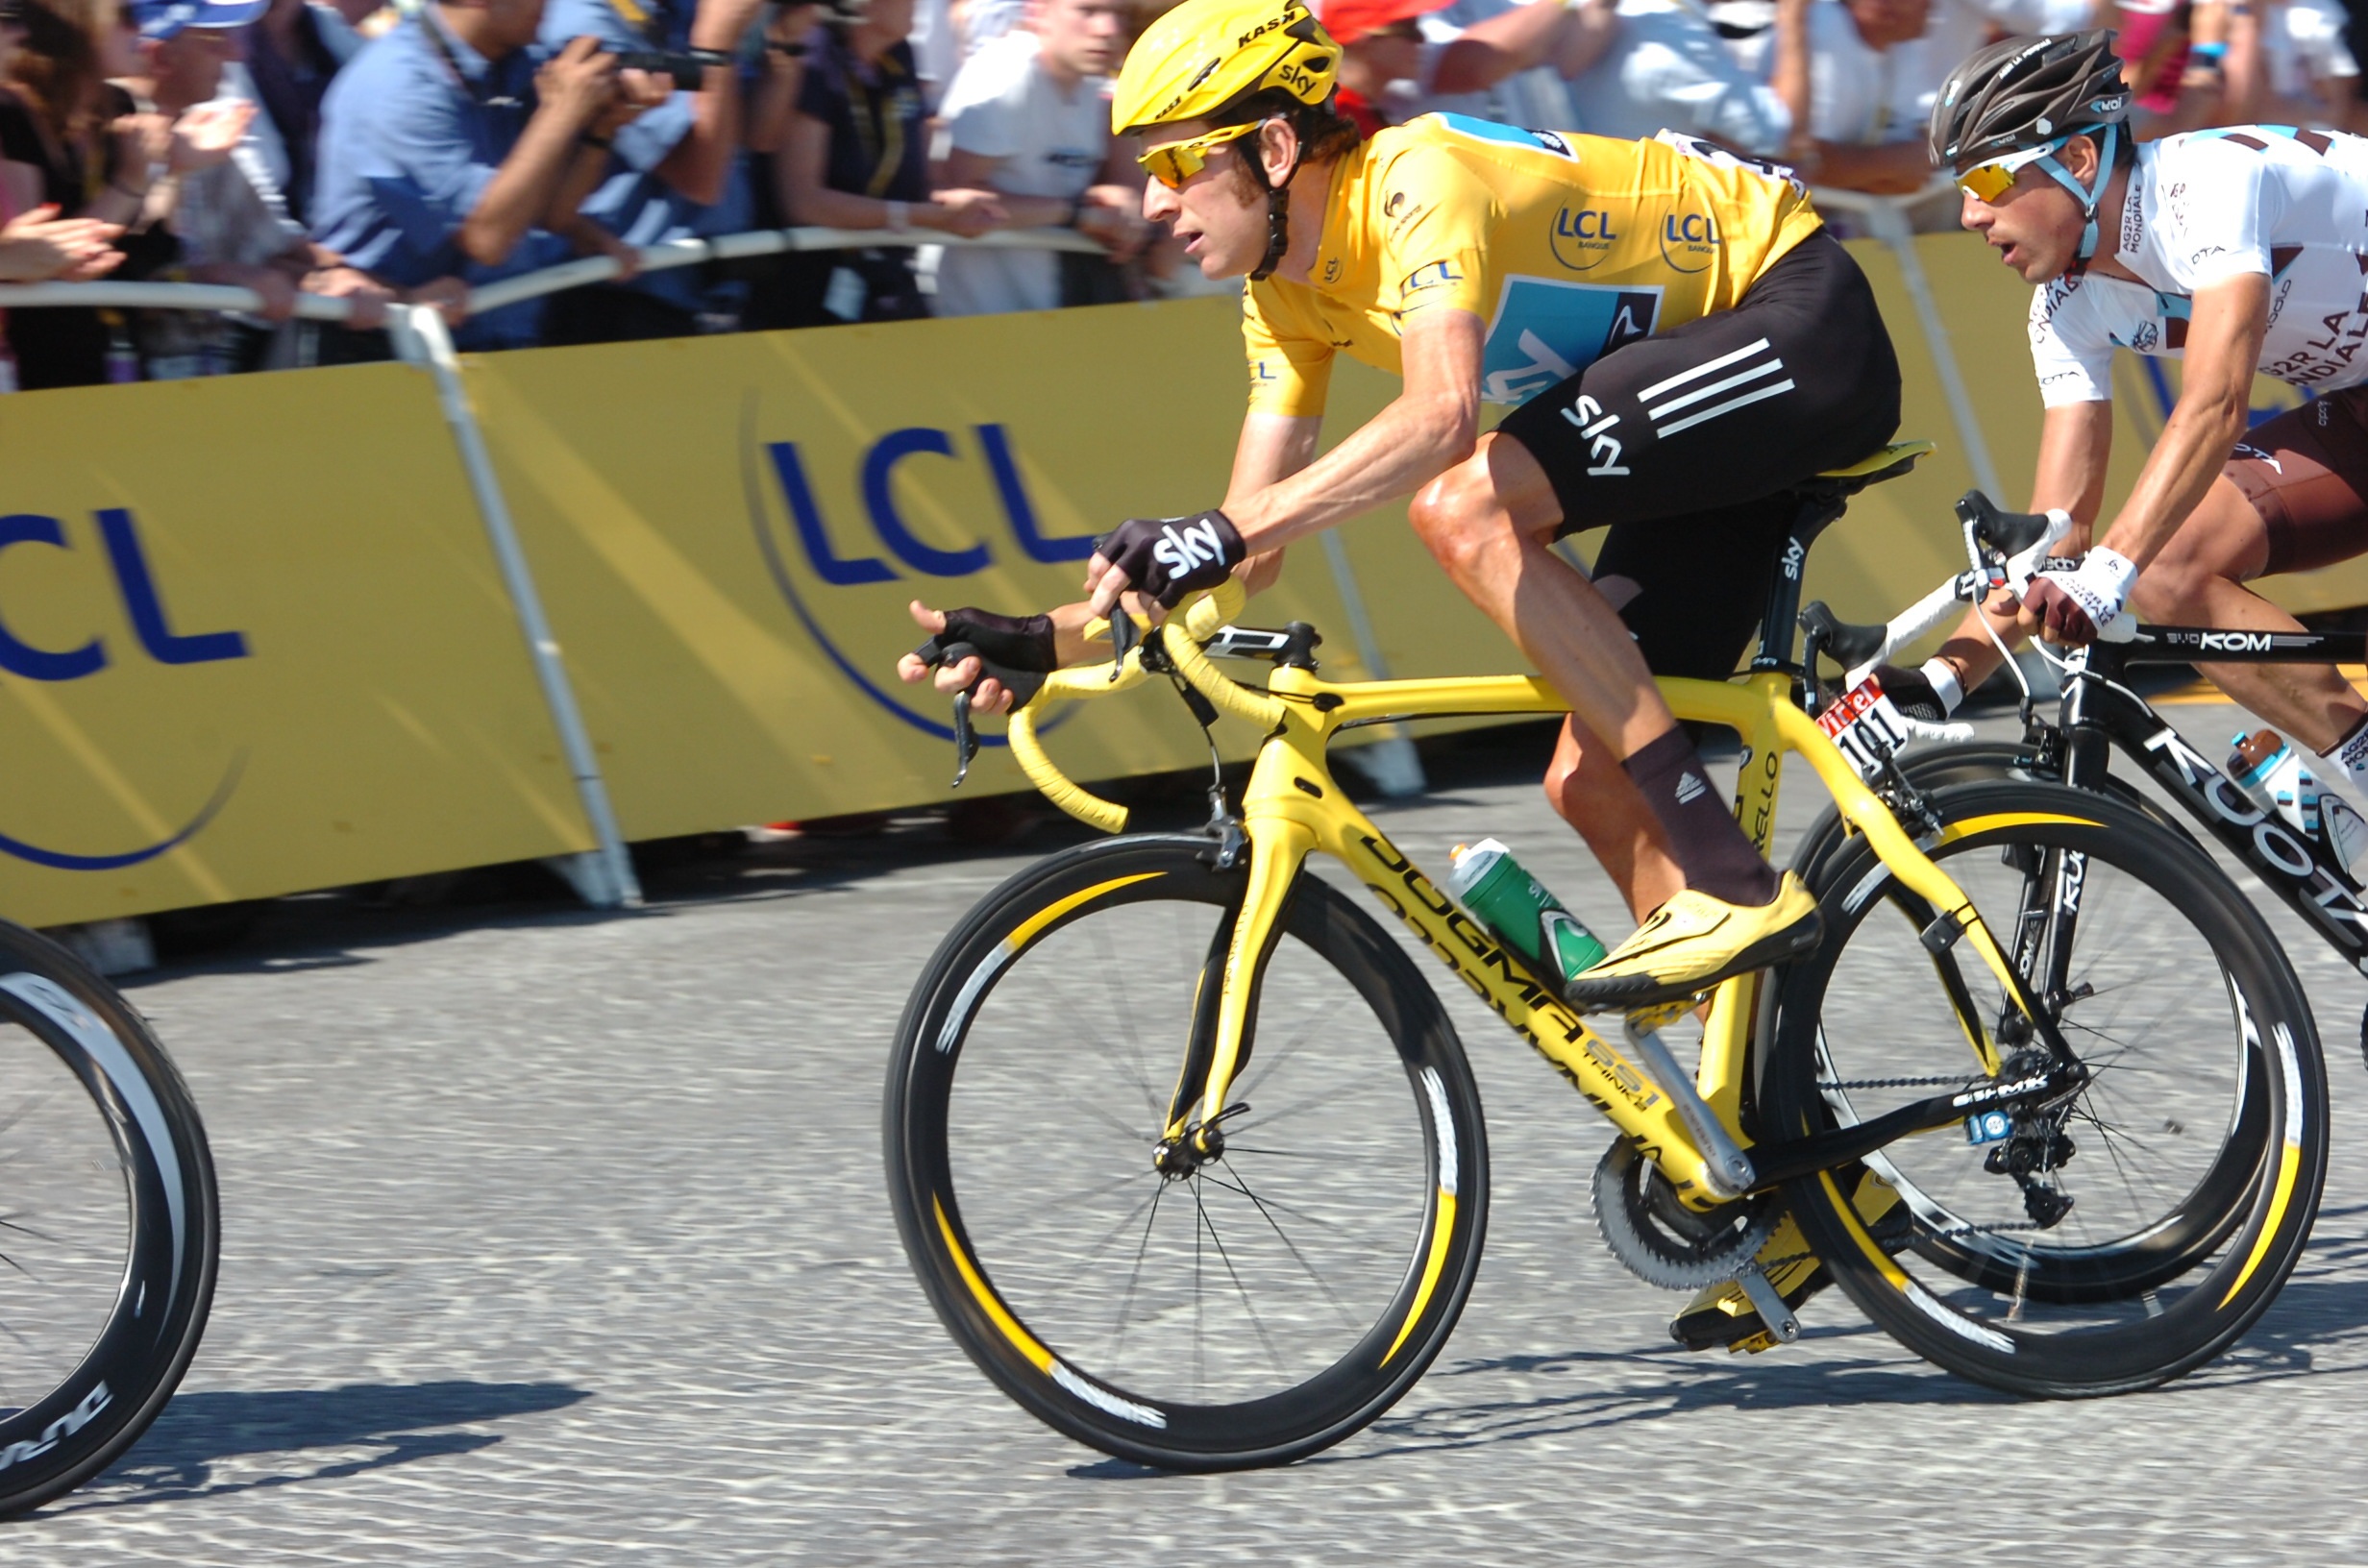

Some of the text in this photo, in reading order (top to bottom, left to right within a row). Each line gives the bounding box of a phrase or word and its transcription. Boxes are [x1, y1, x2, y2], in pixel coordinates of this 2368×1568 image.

[1238, 11, 1295, 49] KASK
[1558, 208, 1616, 240] LCL
[1666, 213, 1721, 245] LCL
[2123, 215, 2133, 252] AG2R
[2131, 184, 2143, 254] MONDIALE
[2306, 310, 2350, 351] LA
[1561, 394, 1631, 477] sky
[765, 423, 1095, 586] LCL
[1153, 519, 1225, 580] sky
[1783, 536, 1804, 580] sky
[2200, 631, 2272, 652] KOM
[1839, 707, 1905, 773] 101
[1360, 834, 1584, 1043] DOGMA
